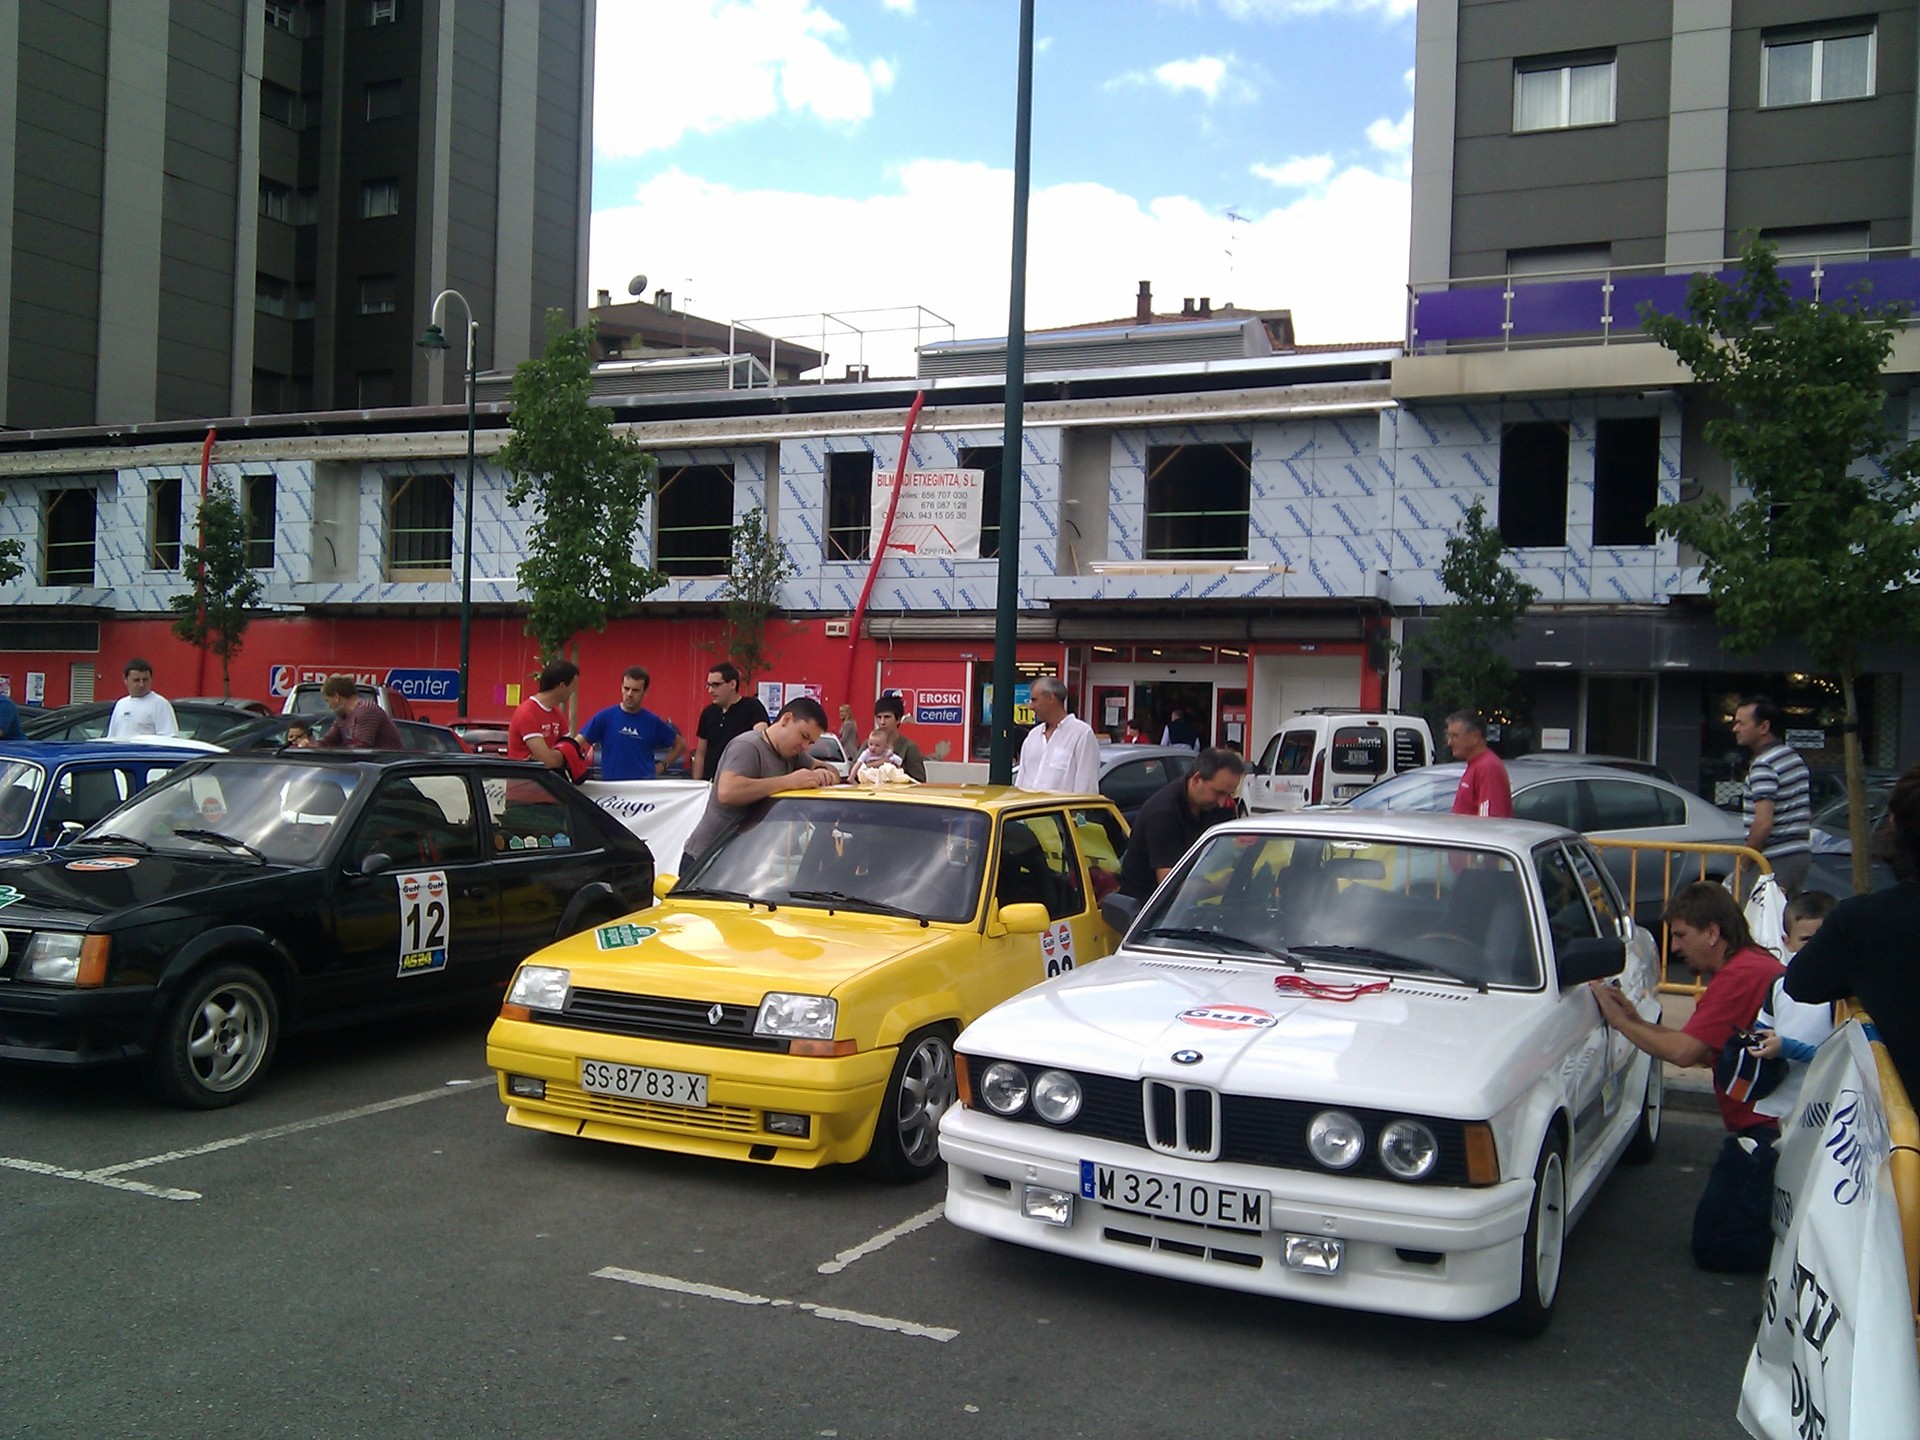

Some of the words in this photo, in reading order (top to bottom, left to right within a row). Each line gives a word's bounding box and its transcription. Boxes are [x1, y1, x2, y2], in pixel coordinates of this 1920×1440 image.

[801, 443, 824, 473] eynobond
[1022, 434, 1046, 464] eynobond
[1344, 463, 1373, 496] eynobond
[1412, 454, 1441, 488] eynobond
[1462, 452, 1493, 487] eynobond
[783, 479, 807, 509] eynobond
[937, 491, 951, 499] 707
[918, 511, 932, 519] 943
[935, 511, 943, 519] 15
[956, 511, 967, 519] 30
[1285, 504, 1313, 537] eynobond
[1332, 503, 1361, 536] eynobond
[1400, 495, 1429, 529] eynobond
[302, 672, 377, 686] ERKI
[391, 675, 450, 696] center
[919, 693, 961, 704] EROSKI
[921, 710, 958, 720] center
[595, 795, 656, 818] Bingo
[406, 900, 445, 951] 12
[1182, 1009, 1272, 1024] Gulf
